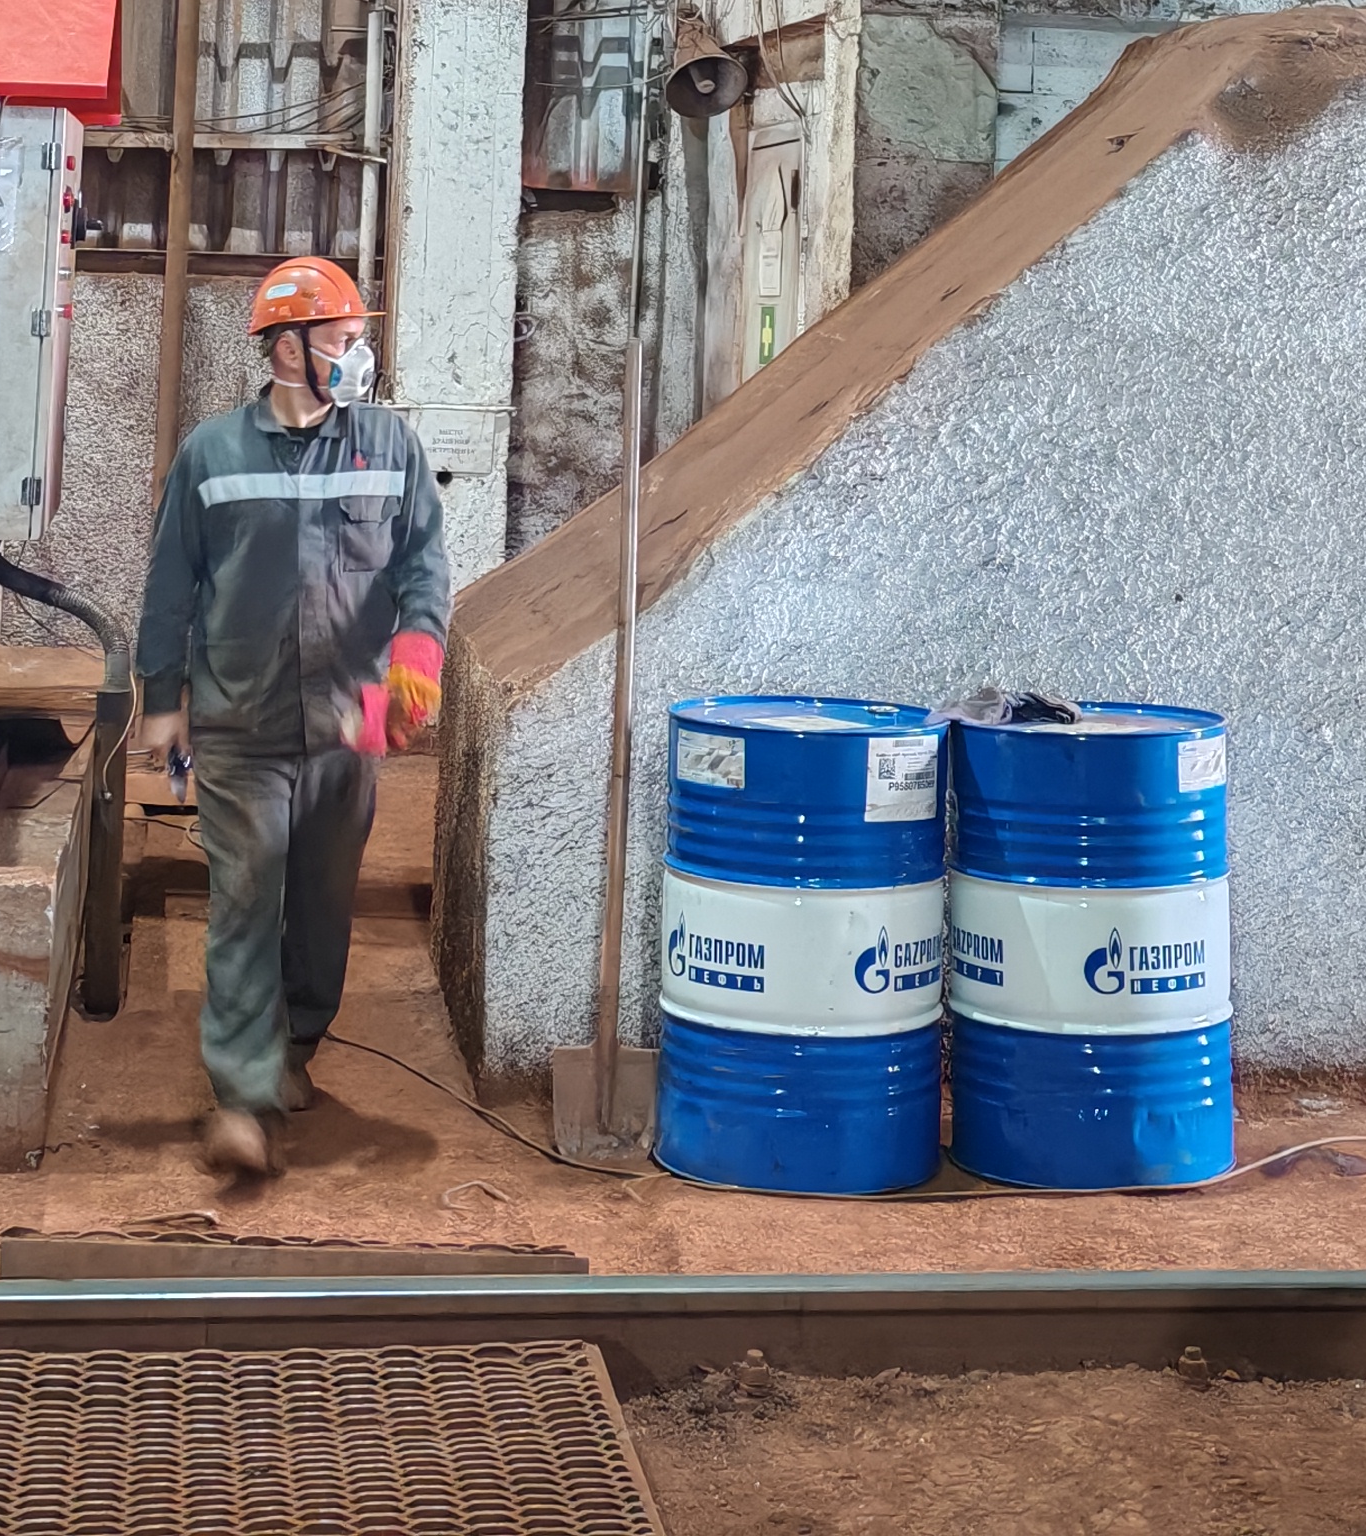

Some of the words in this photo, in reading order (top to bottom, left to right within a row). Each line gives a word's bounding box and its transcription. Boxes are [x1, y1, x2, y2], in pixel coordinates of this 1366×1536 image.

[689, 933, 765, 970] ГАЗПРОМ
[1128, 939, 1205, 972] ГАЗПРОМ
[690, 967, 761, 990] НЕФТЬ
[1134, 974, 1204, 992] НЕФТЬ
